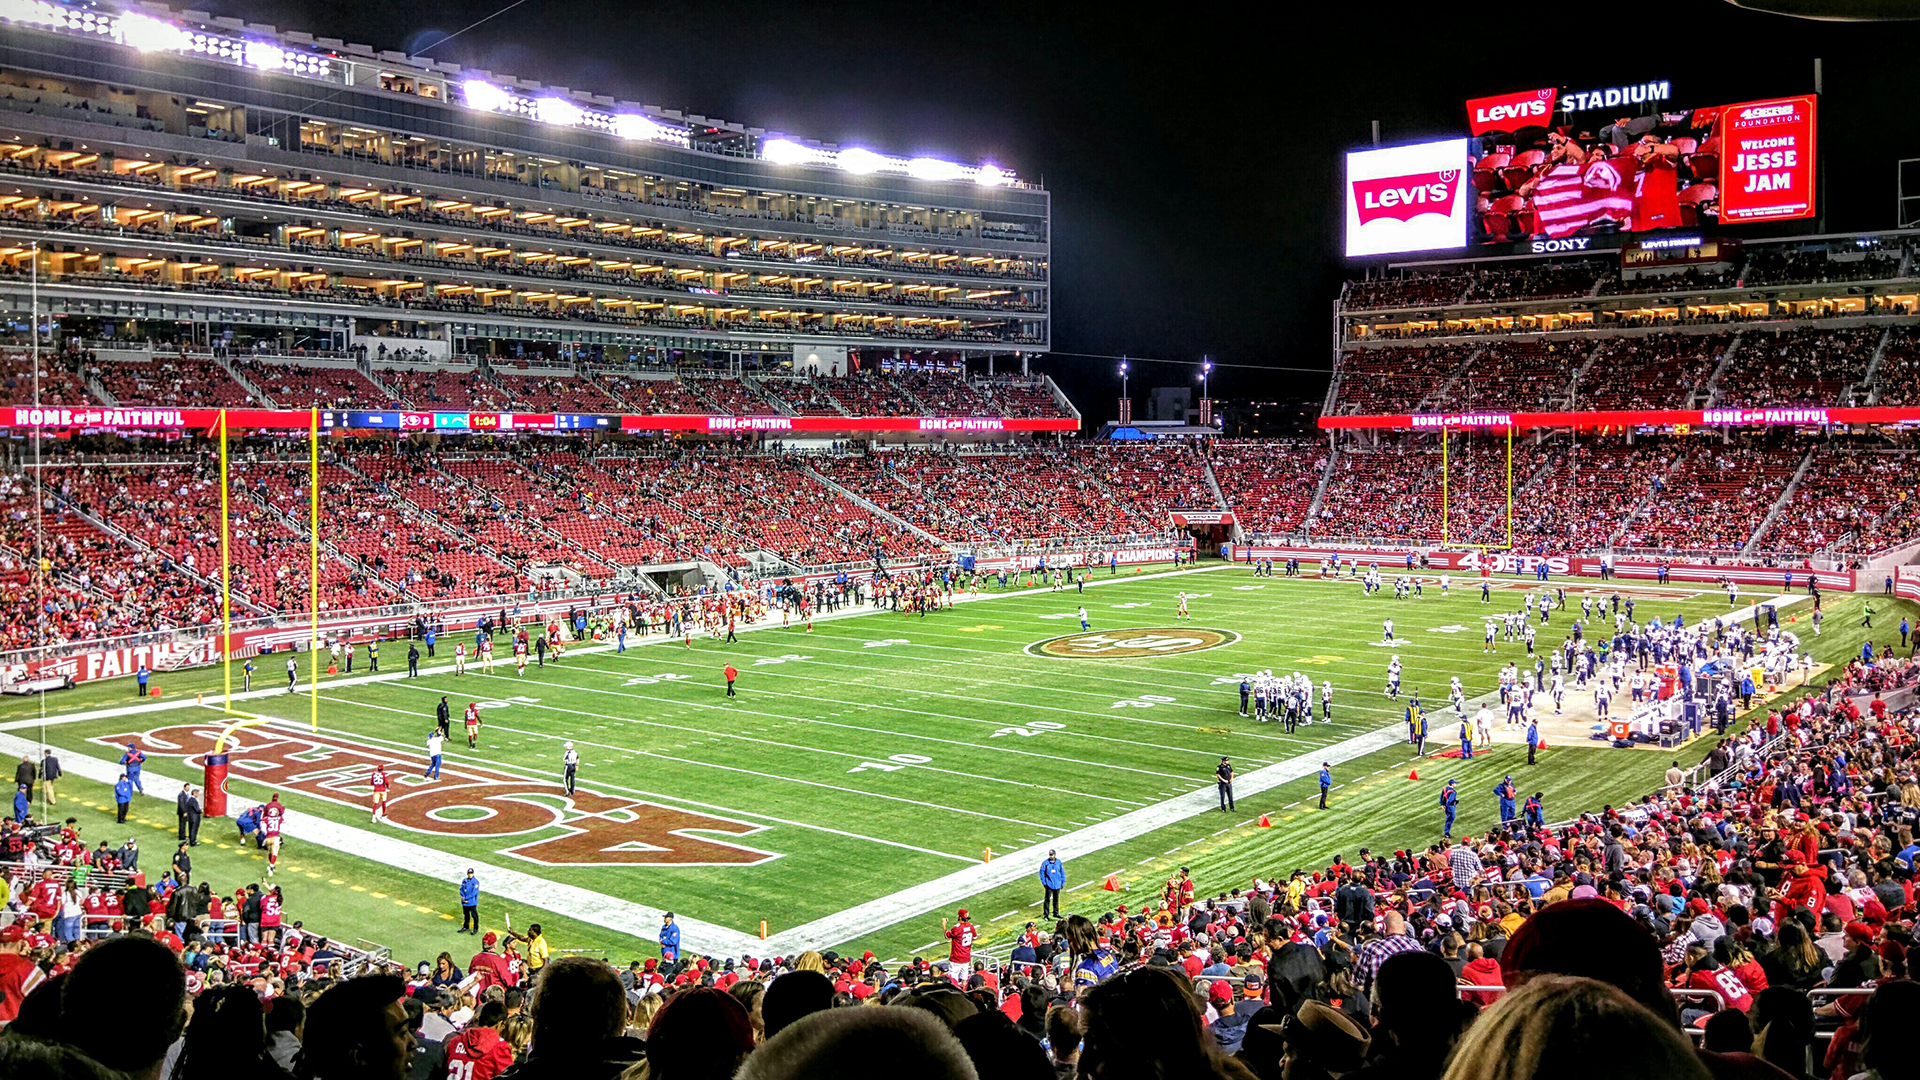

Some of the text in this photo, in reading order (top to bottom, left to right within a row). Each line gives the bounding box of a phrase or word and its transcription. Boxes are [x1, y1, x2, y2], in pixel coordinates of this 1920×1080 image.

[1562, 82, 1668, 112] STADIUM
[1735, 115, 1800, 128] FOUNDATION
[1741, 137, 1794, 150] WELCOME
[1732, 150, 1797, 172] JESSE
[1744, 172, 1790, 193] JAM
[1532, 238, 1589, 253] SONY
[16, 410, 72, 425] HOME
[104, 410, 184, 425] FAITHFUL
[474, 416, 496, 426] 1:04
[1412, 416, 1443, 426] HOME
[1461, 415, 1512, 425] FAITHFUL
[1703, 411, 1742, 422] HOME
[1765, 410, 1828, 421] FAITHFUL
[709, 418, 736, 428] HOME
[752, 418, 792, 428] FAITHFUL
[920, 419, 947, 429] HOME
[963, 419, 1003, 429] FAITHFUL
[1674, 424, 1688, 433] 25
[1116, 548, 1175, 563] CHAMPIONS
[1457, 552, 1570, 575] 49ERS
[998, 721, 1066, 737] 20
[1614, 724, 1624, 733] G
[860, 754, 932, 772] 10
[48, 889, 56, 904] 7
[91, 896, 100, 907] 9
[1807, 897, 1816, 908] 8
